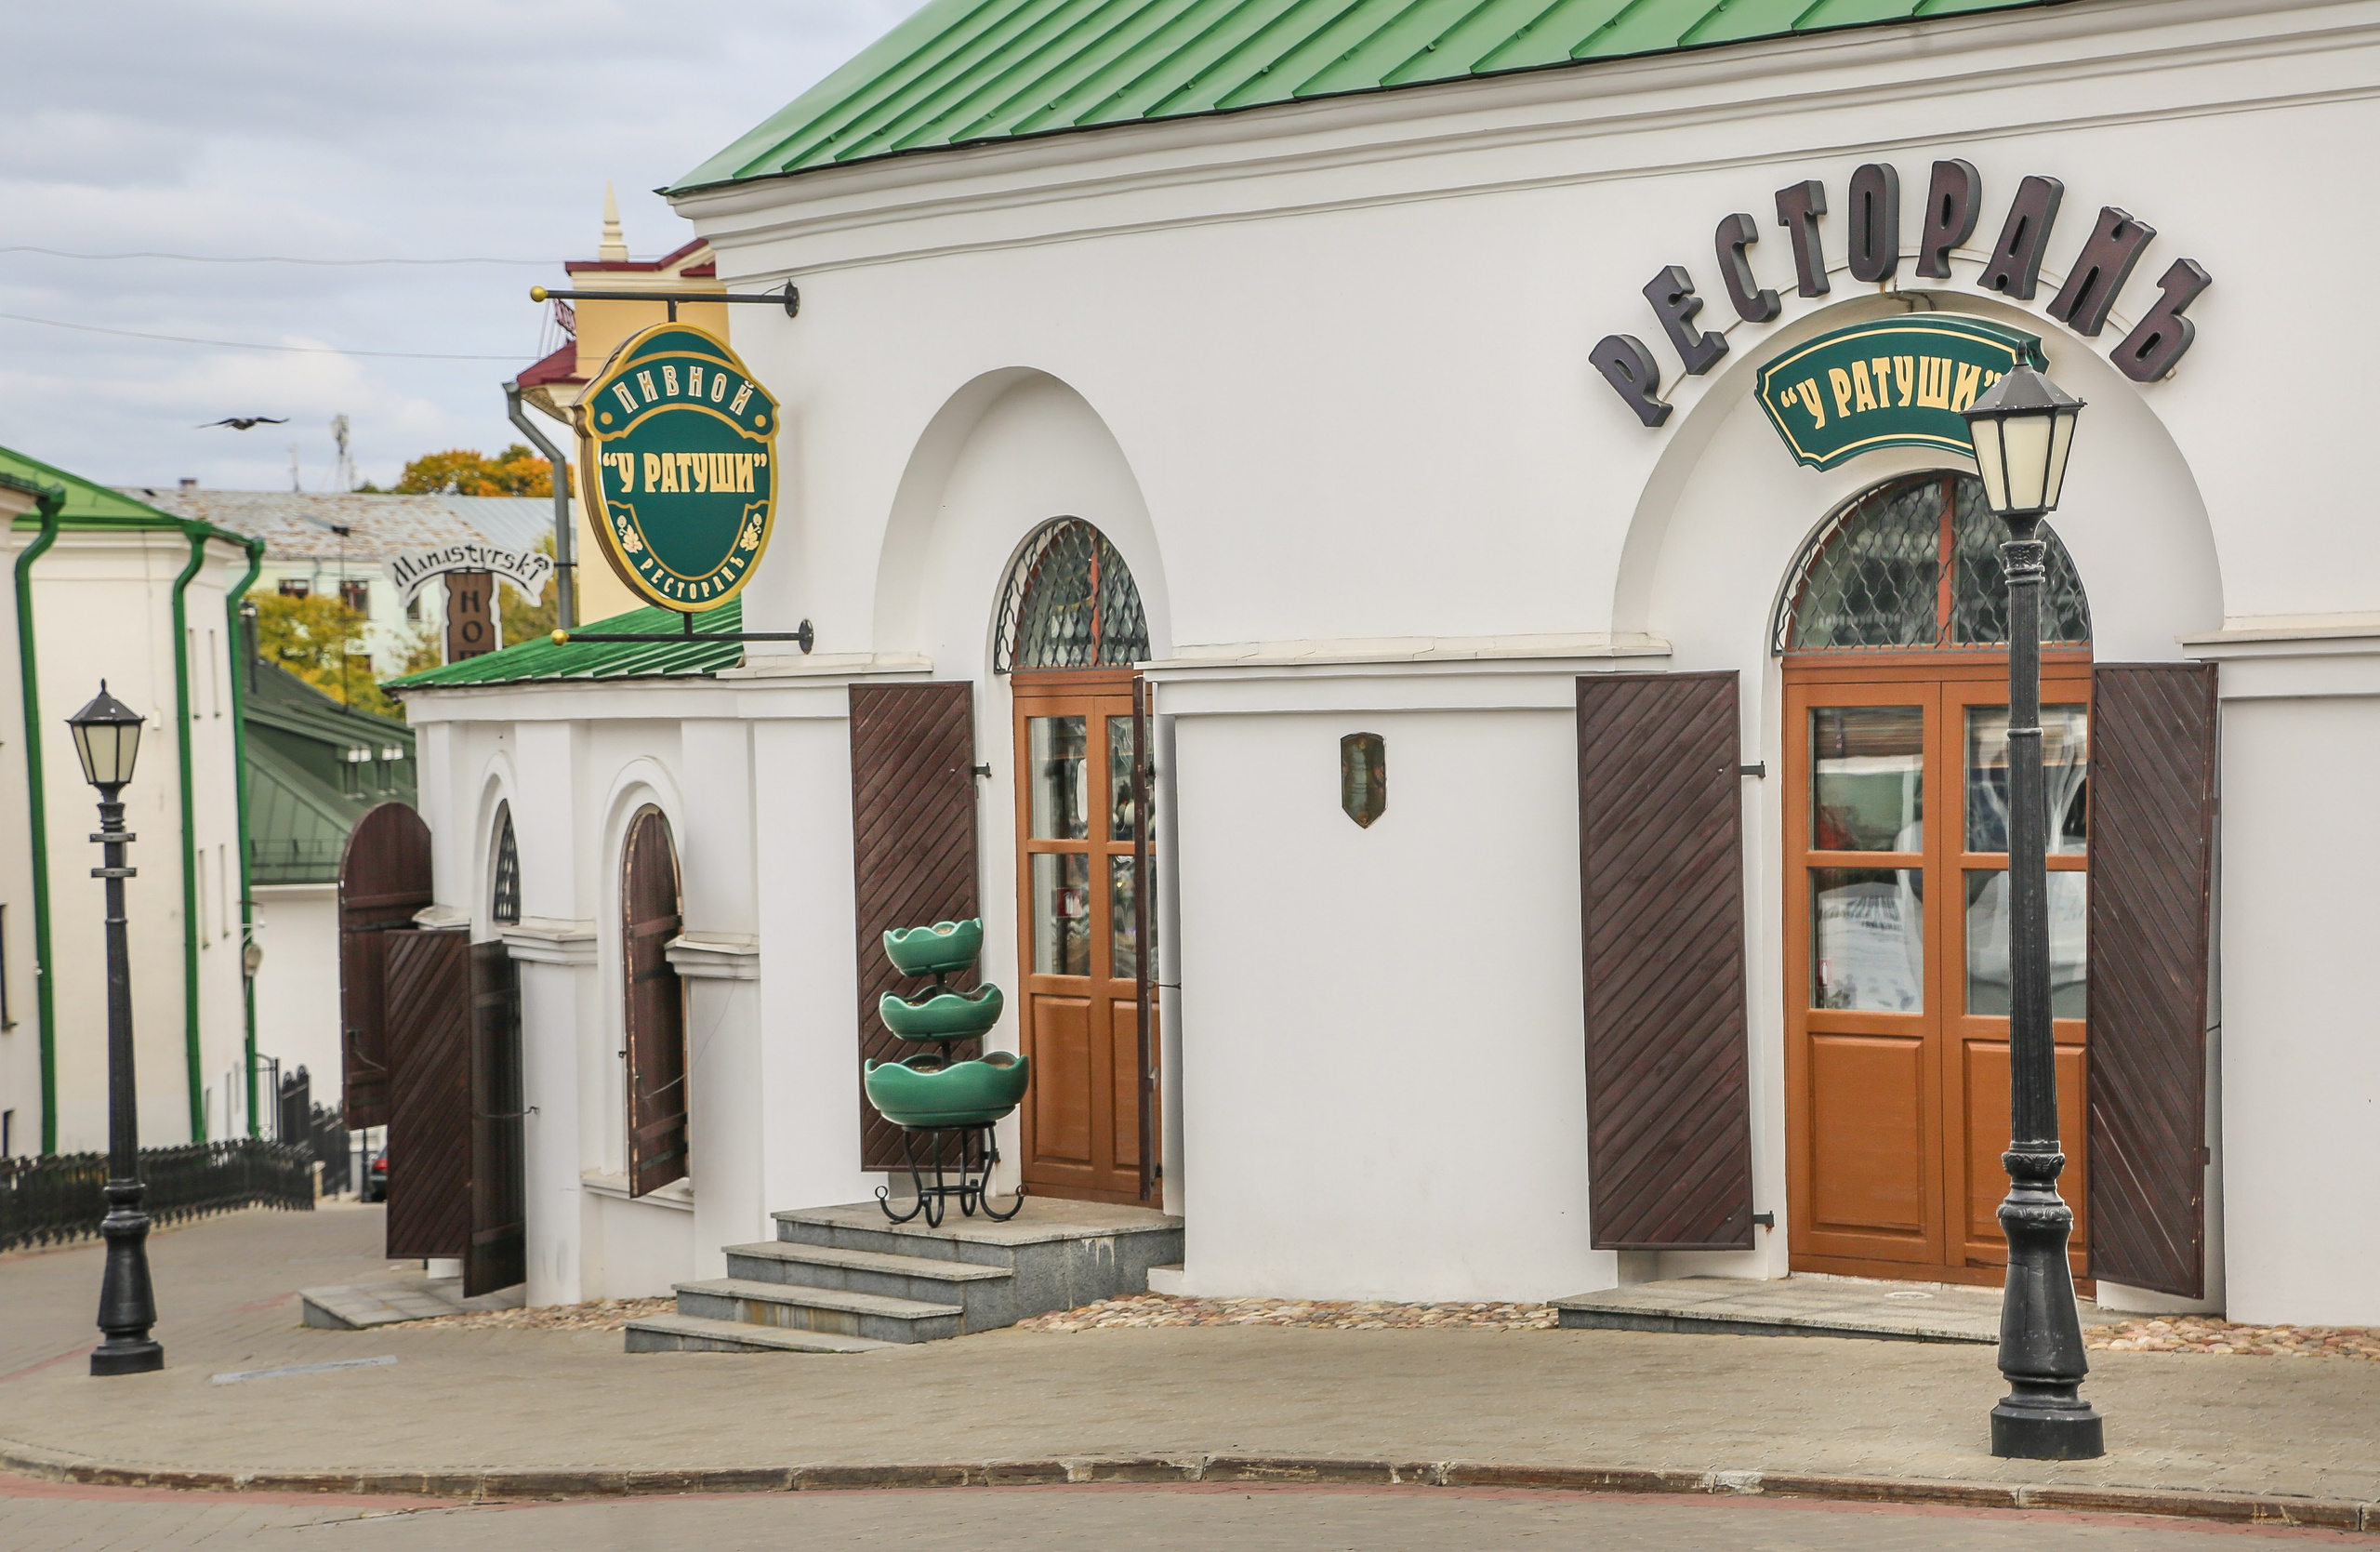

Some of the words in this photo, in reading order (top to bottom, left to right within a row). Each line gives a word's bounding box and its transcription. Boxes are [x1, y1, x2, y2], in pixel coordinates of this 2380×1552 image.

[1588, 158, 2213, 427] РЕСТОРАНЪ
[612, 365, 755, 416] ПИВНОЙ
[640, 556, 745, 600] РЕСТОРАНЪ
